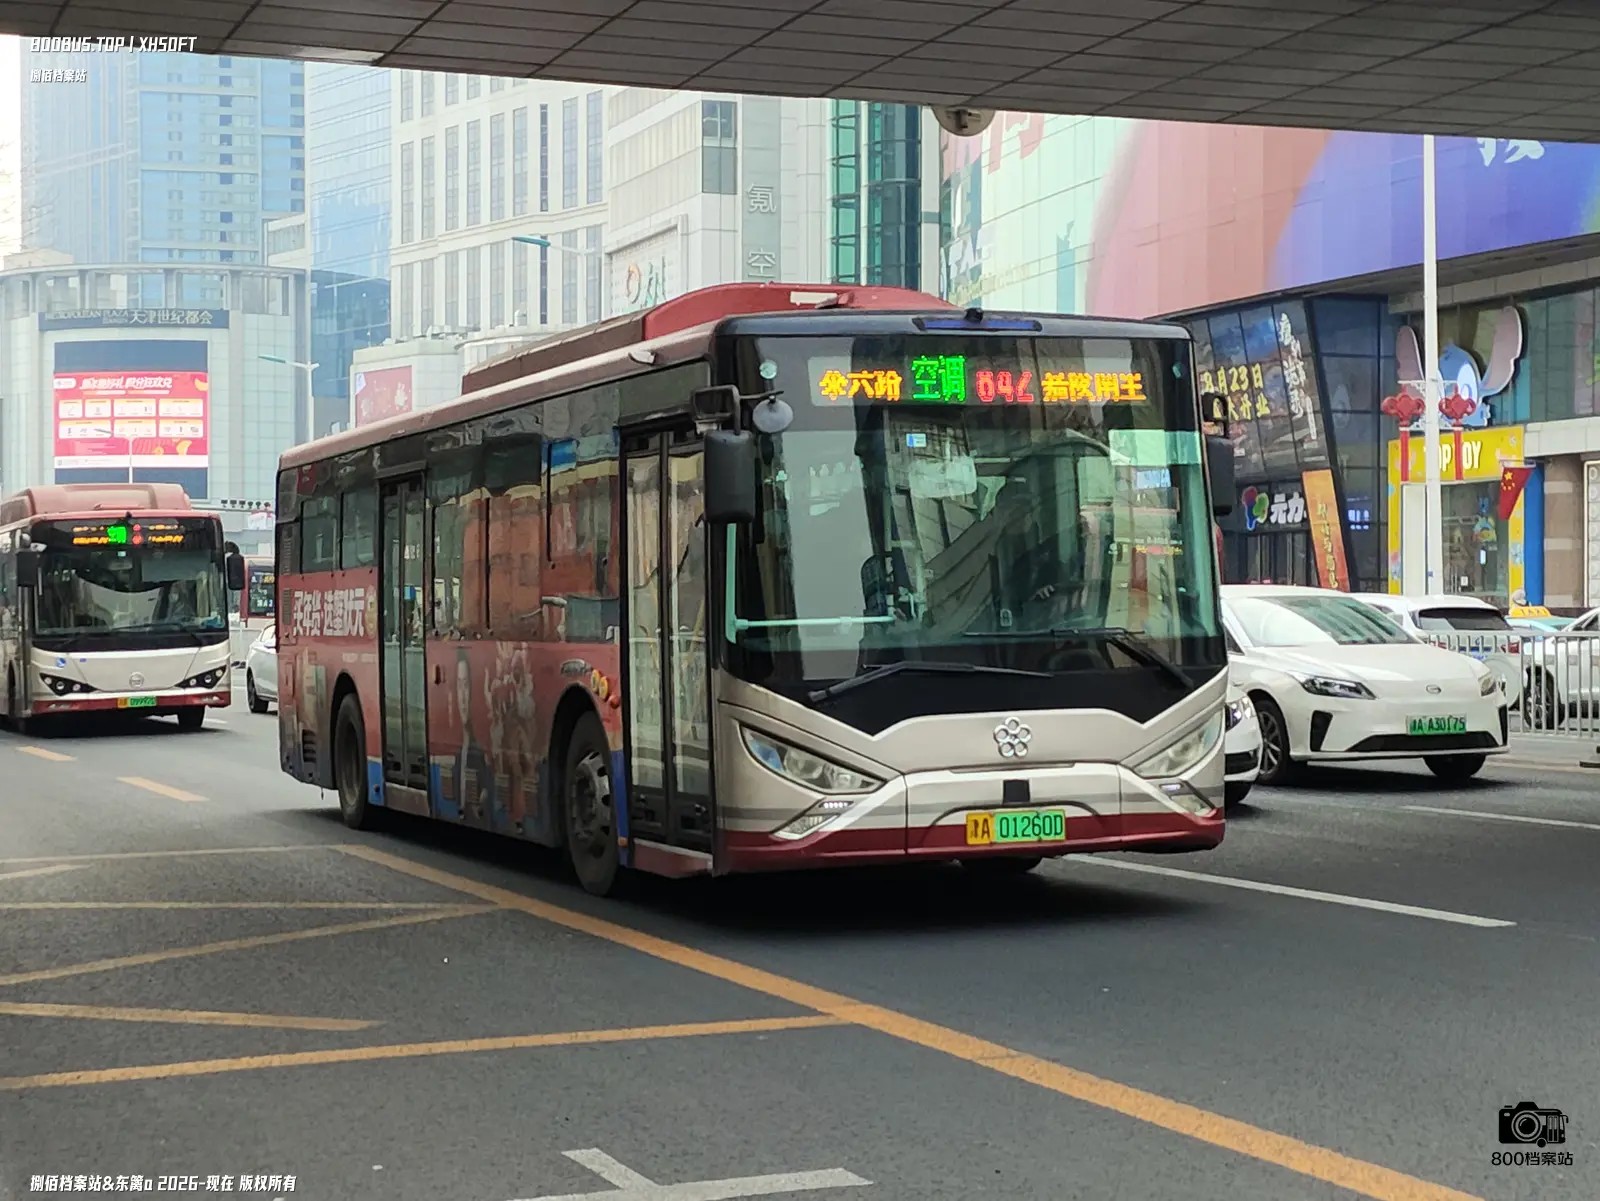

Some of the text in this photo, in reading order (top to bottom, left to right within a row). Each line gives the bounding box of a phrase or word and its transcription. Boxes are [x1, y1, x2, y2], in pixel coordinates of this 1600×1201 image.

[129, 309, 213, 325] 天津世纪都会
[912, 355, 965, 401] 空调
[1270, 491, 1308, 524] 元力
